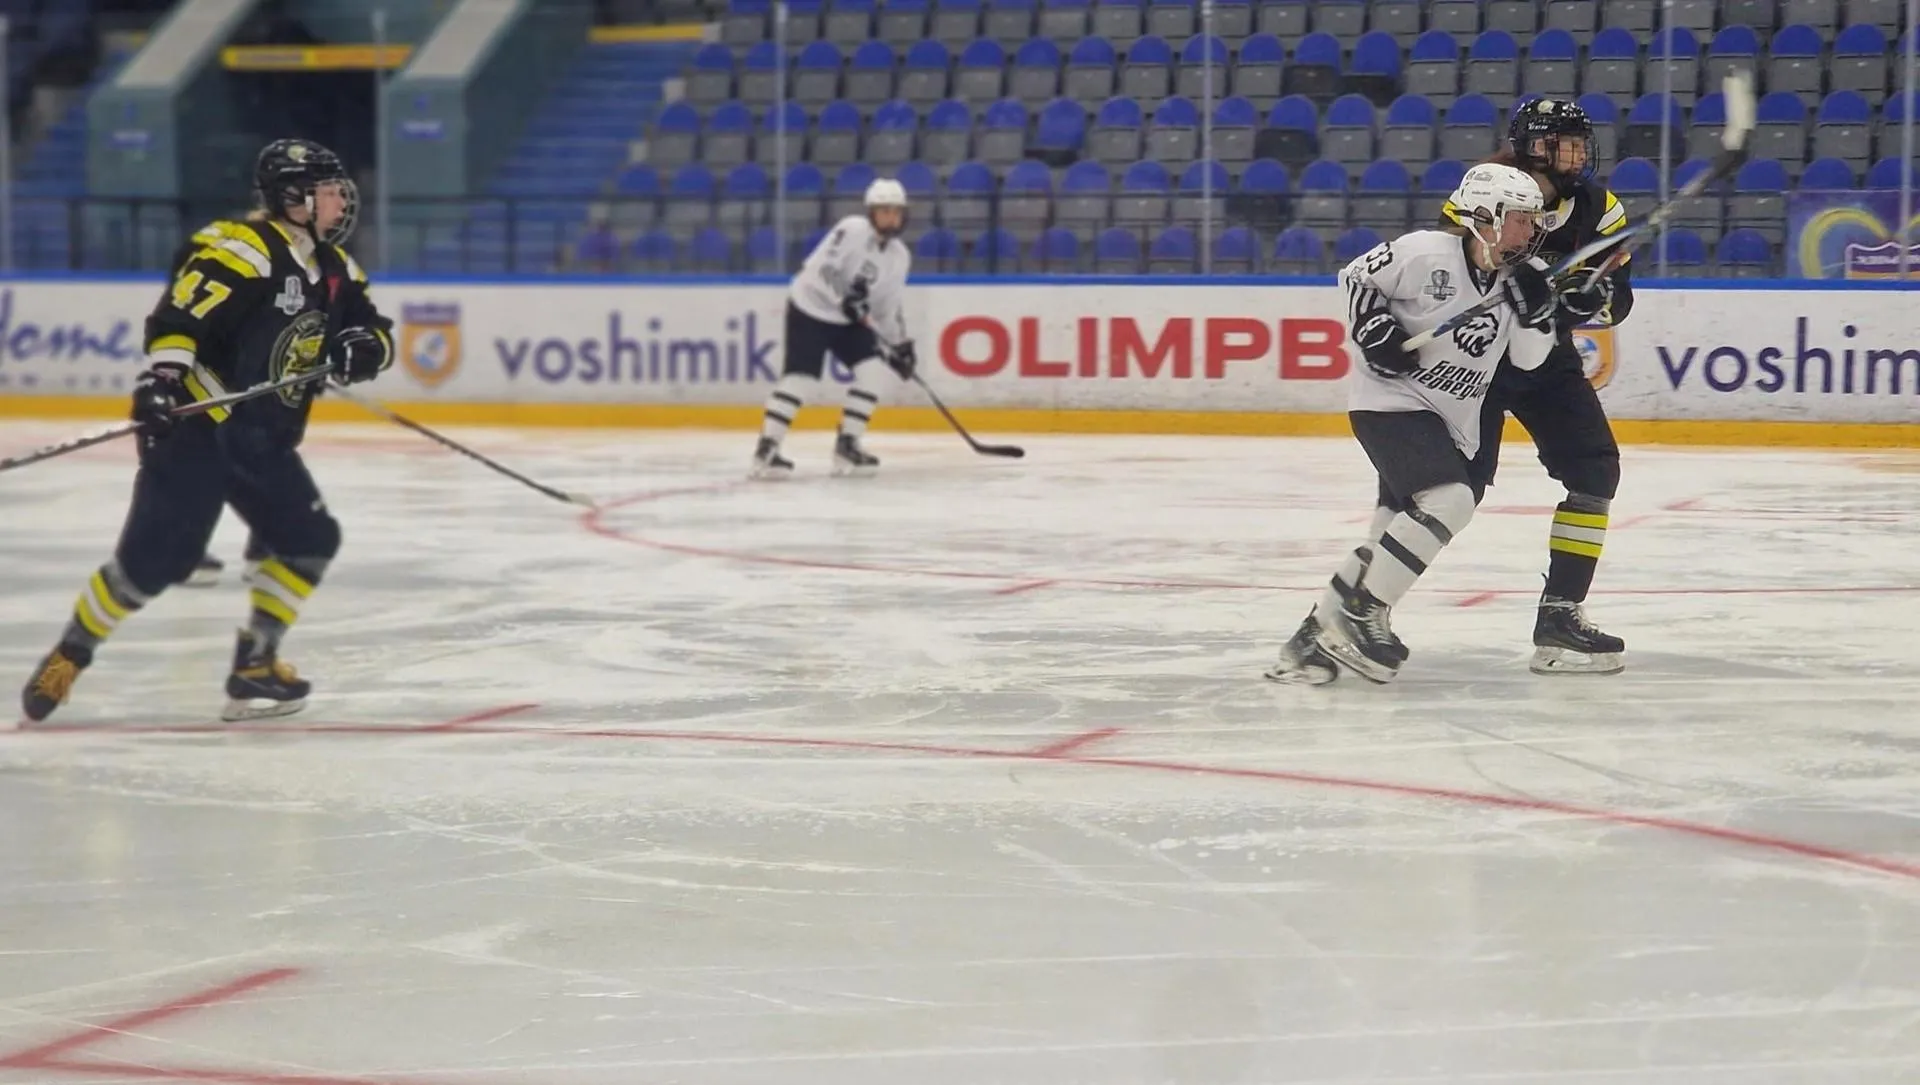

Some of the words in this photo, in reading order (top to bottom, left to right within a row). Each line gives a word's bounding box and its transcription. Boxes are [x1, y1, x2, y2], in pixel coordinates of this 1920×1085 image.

[1365, 241, 1394, 276] 33
[172, 269, 232, 320] 47
[1655, 316, 1920, 395] voshim
